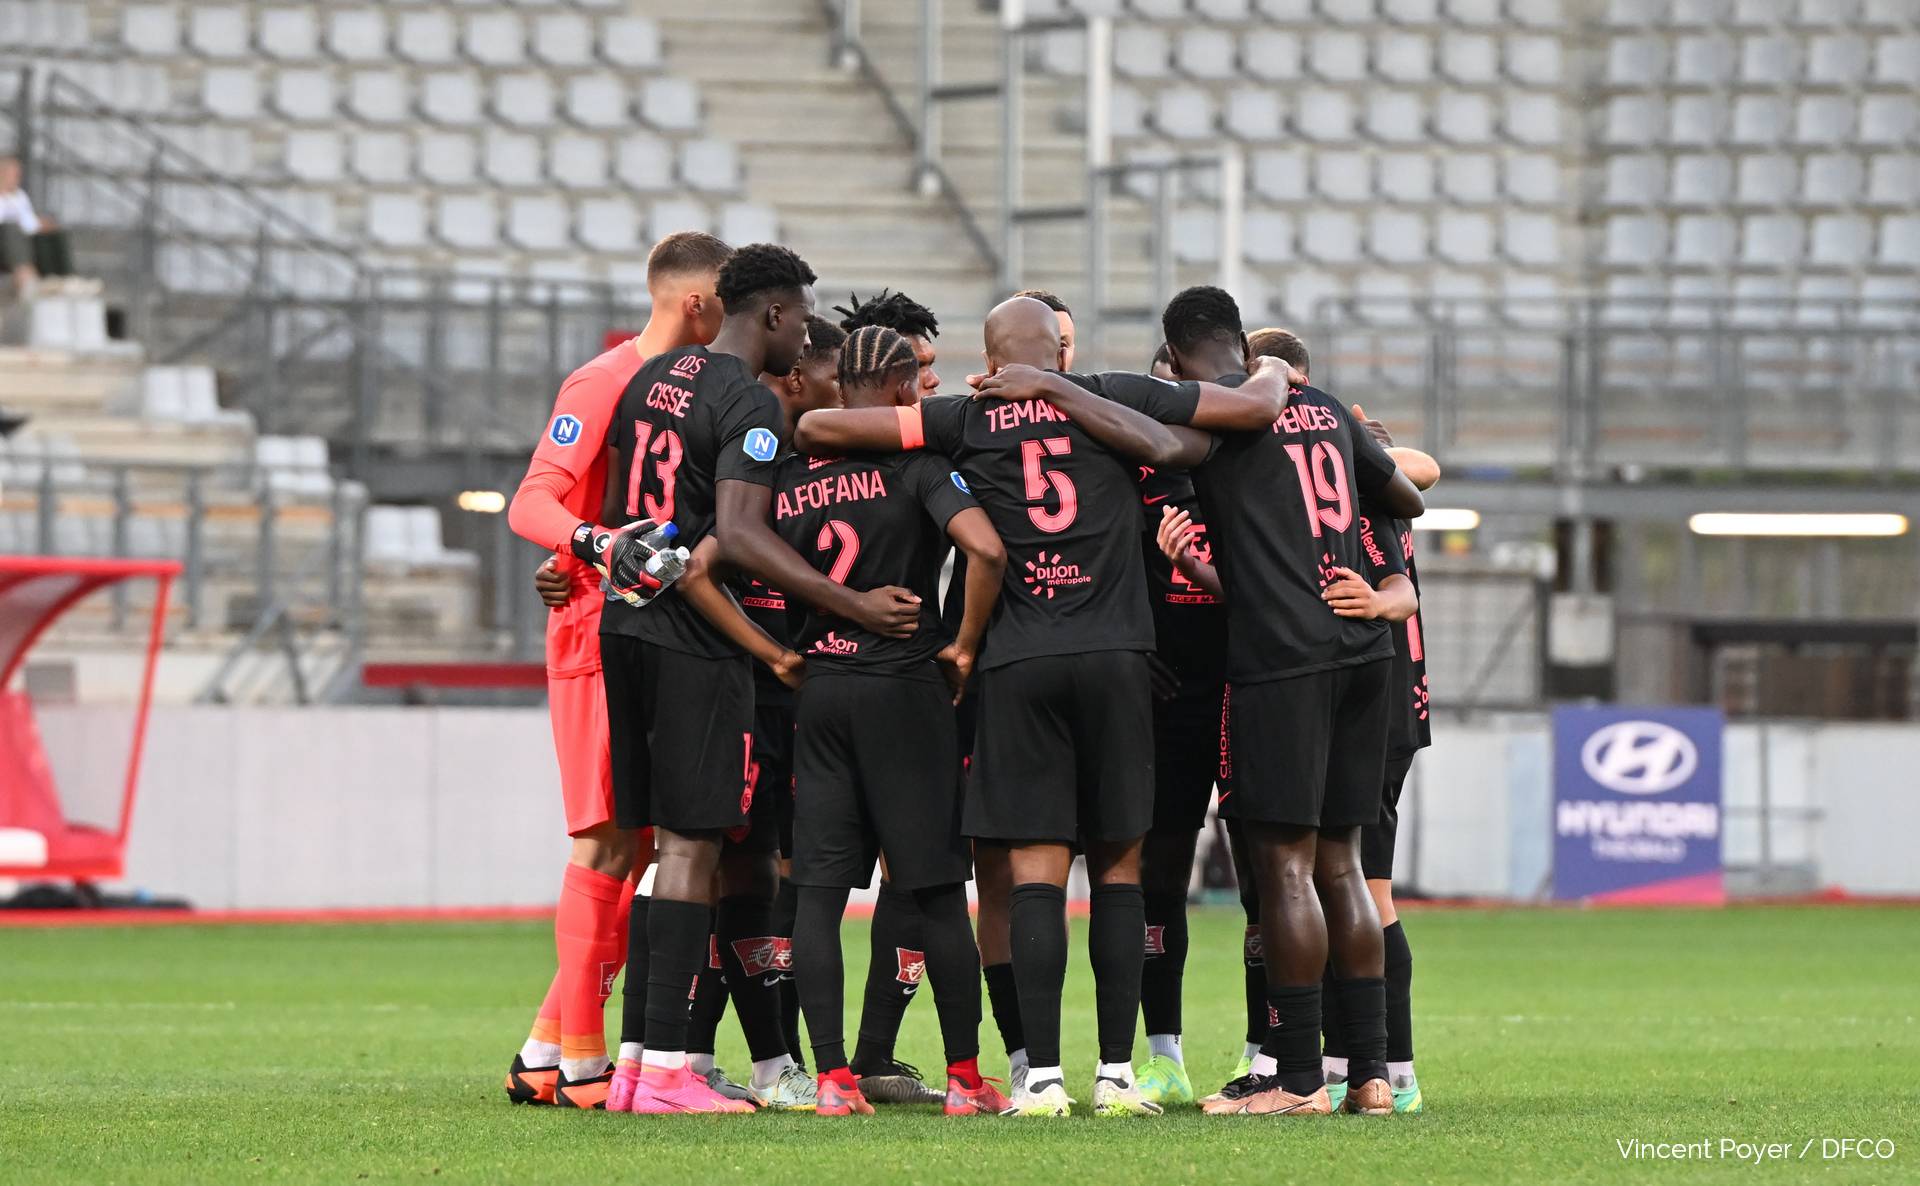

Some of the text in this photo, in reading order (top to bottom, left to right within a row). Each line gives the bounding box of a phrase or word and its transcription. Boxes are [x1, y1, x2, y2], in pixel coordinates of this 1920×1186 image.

[646, 381, 693, 418] CISSE
[985, 399, 1069, 433] TEMAN
[1272, 404, 1338, 434] MENDES
[626, 419, 683, 524] 13
[1021, 436, 1078, 533] 5
[1283, 440, 1352, 538] 19
[776, 469, 887, 520] A.FOFANA
[817, 519, 860, 588] 2
[1361, 531, 1386, 567] leader
[1047, 575, 1092, 586] métropole
[1557, 800, 1718, 838] HYUNDAI
